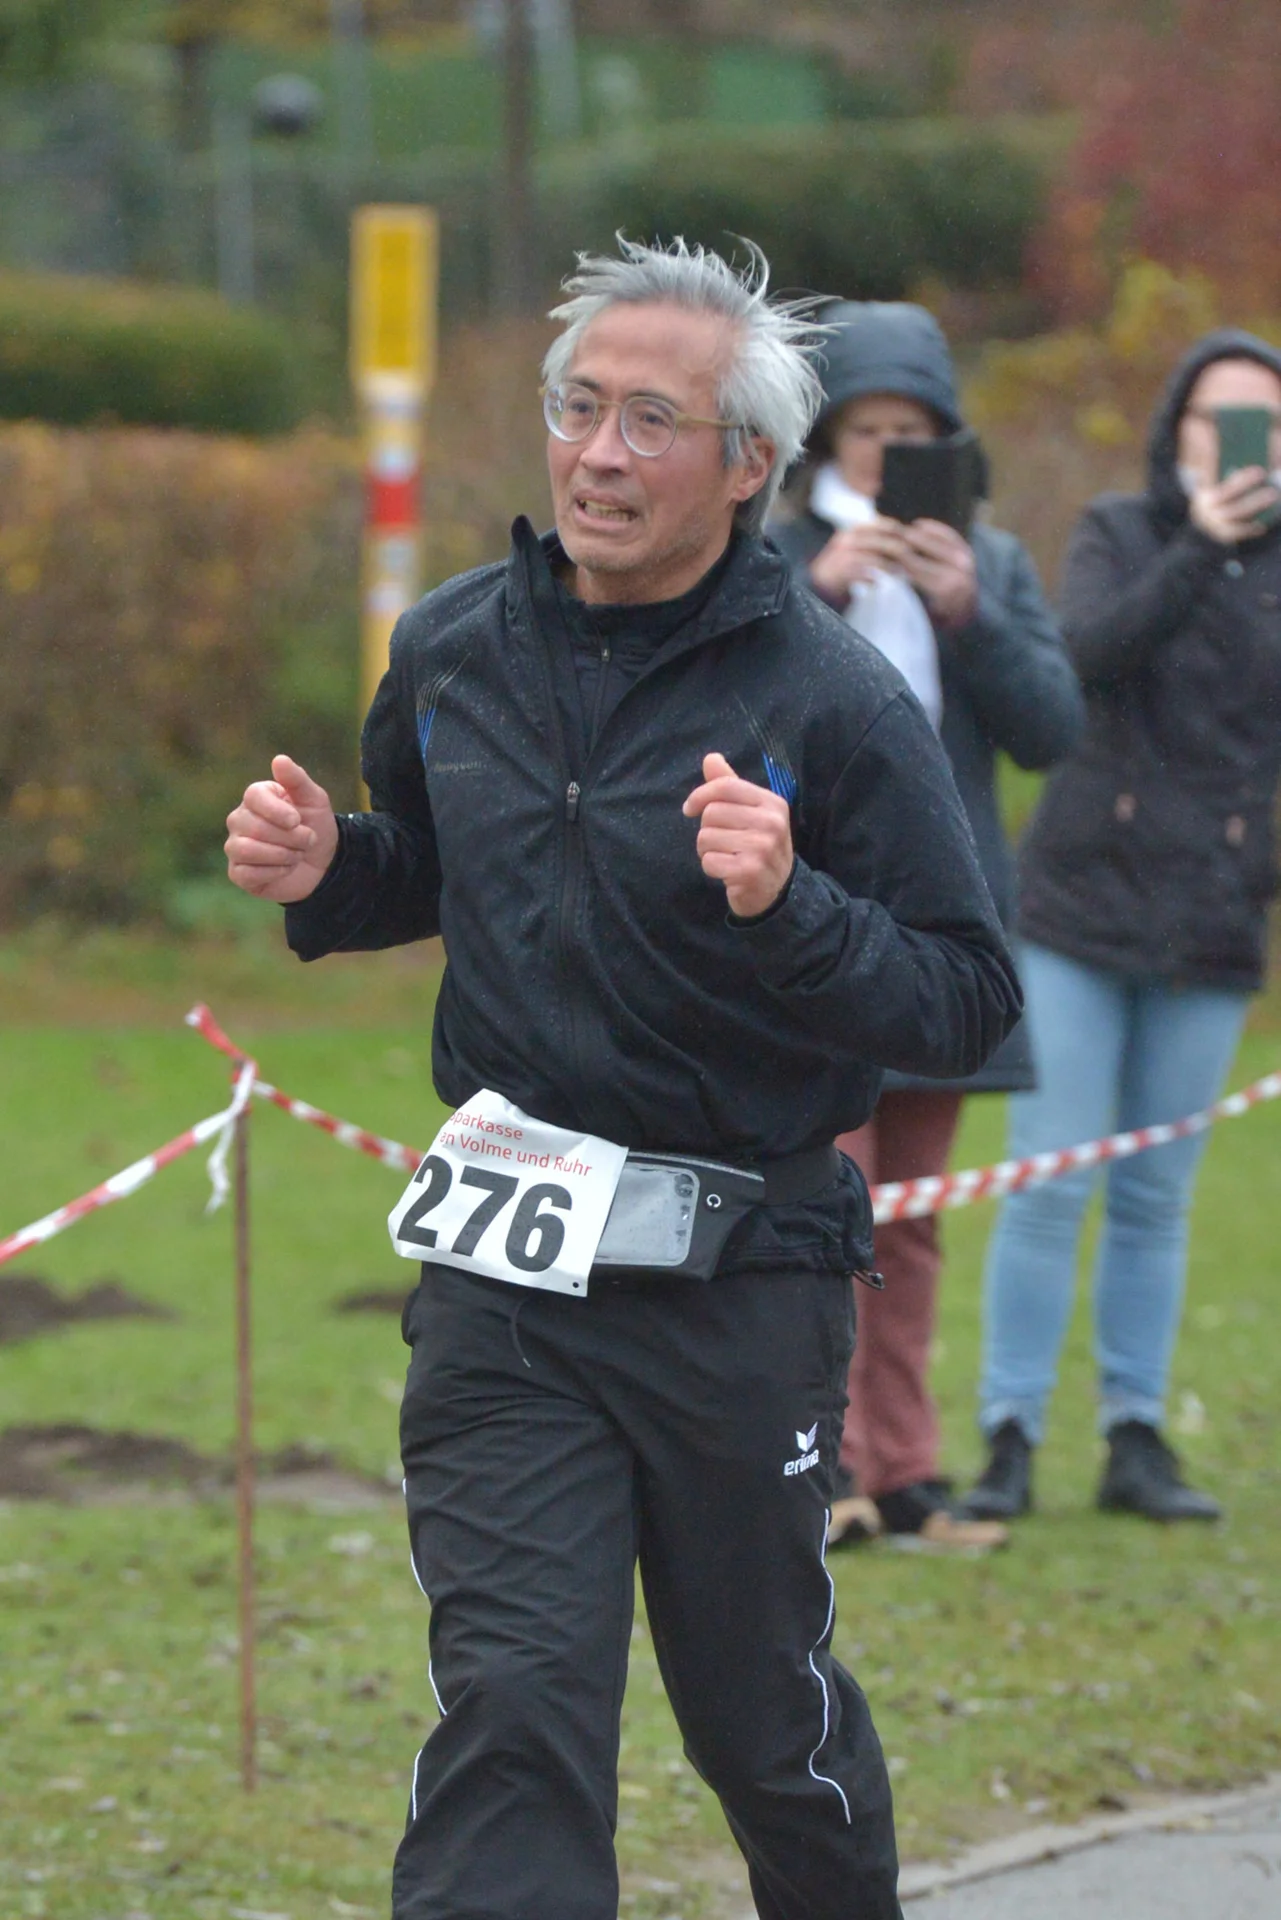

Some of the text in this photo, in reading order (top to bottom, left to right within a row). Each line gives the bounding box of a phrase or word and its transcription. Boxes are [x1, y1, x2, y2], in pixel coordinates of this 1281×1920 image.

[460, 1133, 512, 1160] Volme
[516, 1150, 550, 1169] und
[553, 1156, 593, 1176] Ruhr
[397, 1154, 573, 1273] 276
